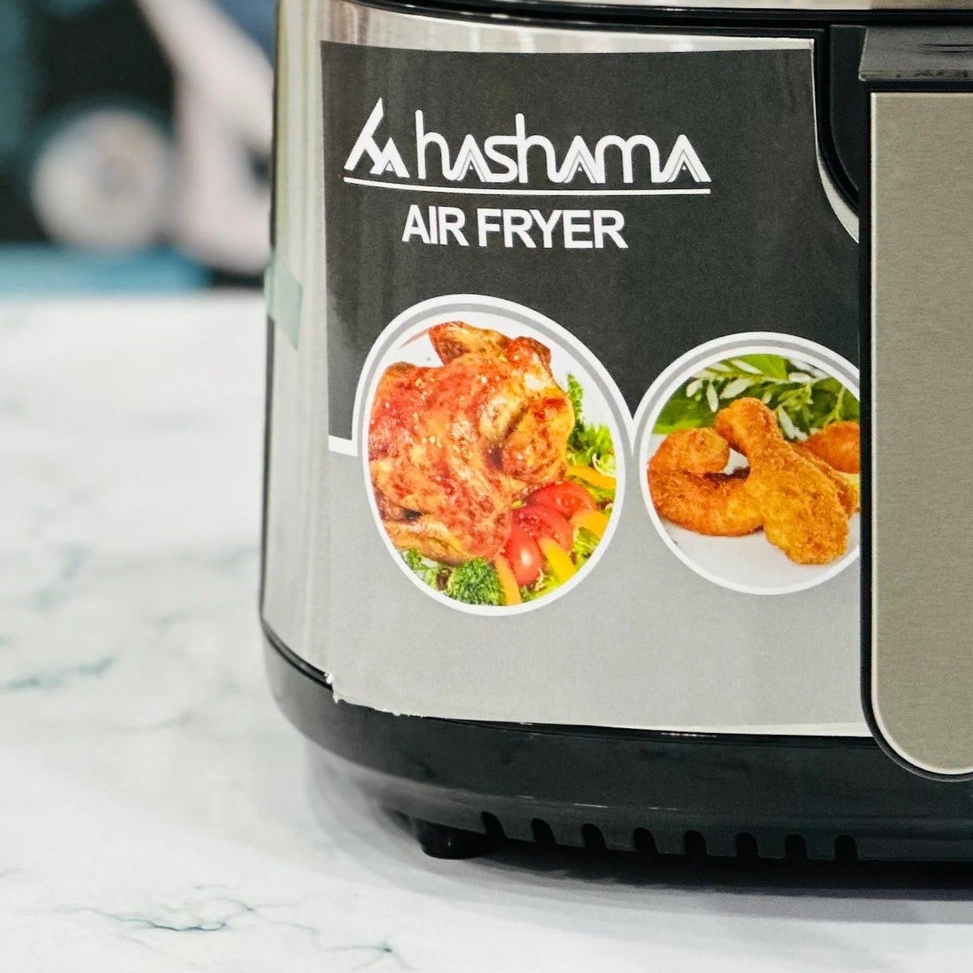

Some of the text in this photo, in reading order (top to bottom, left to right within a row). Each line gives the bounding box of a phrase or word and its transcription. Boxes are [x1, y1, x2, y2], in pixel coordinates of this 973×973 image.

[415, 109, 712, 184] hashama
[401, 204, 629, 249] AIR FRYER
